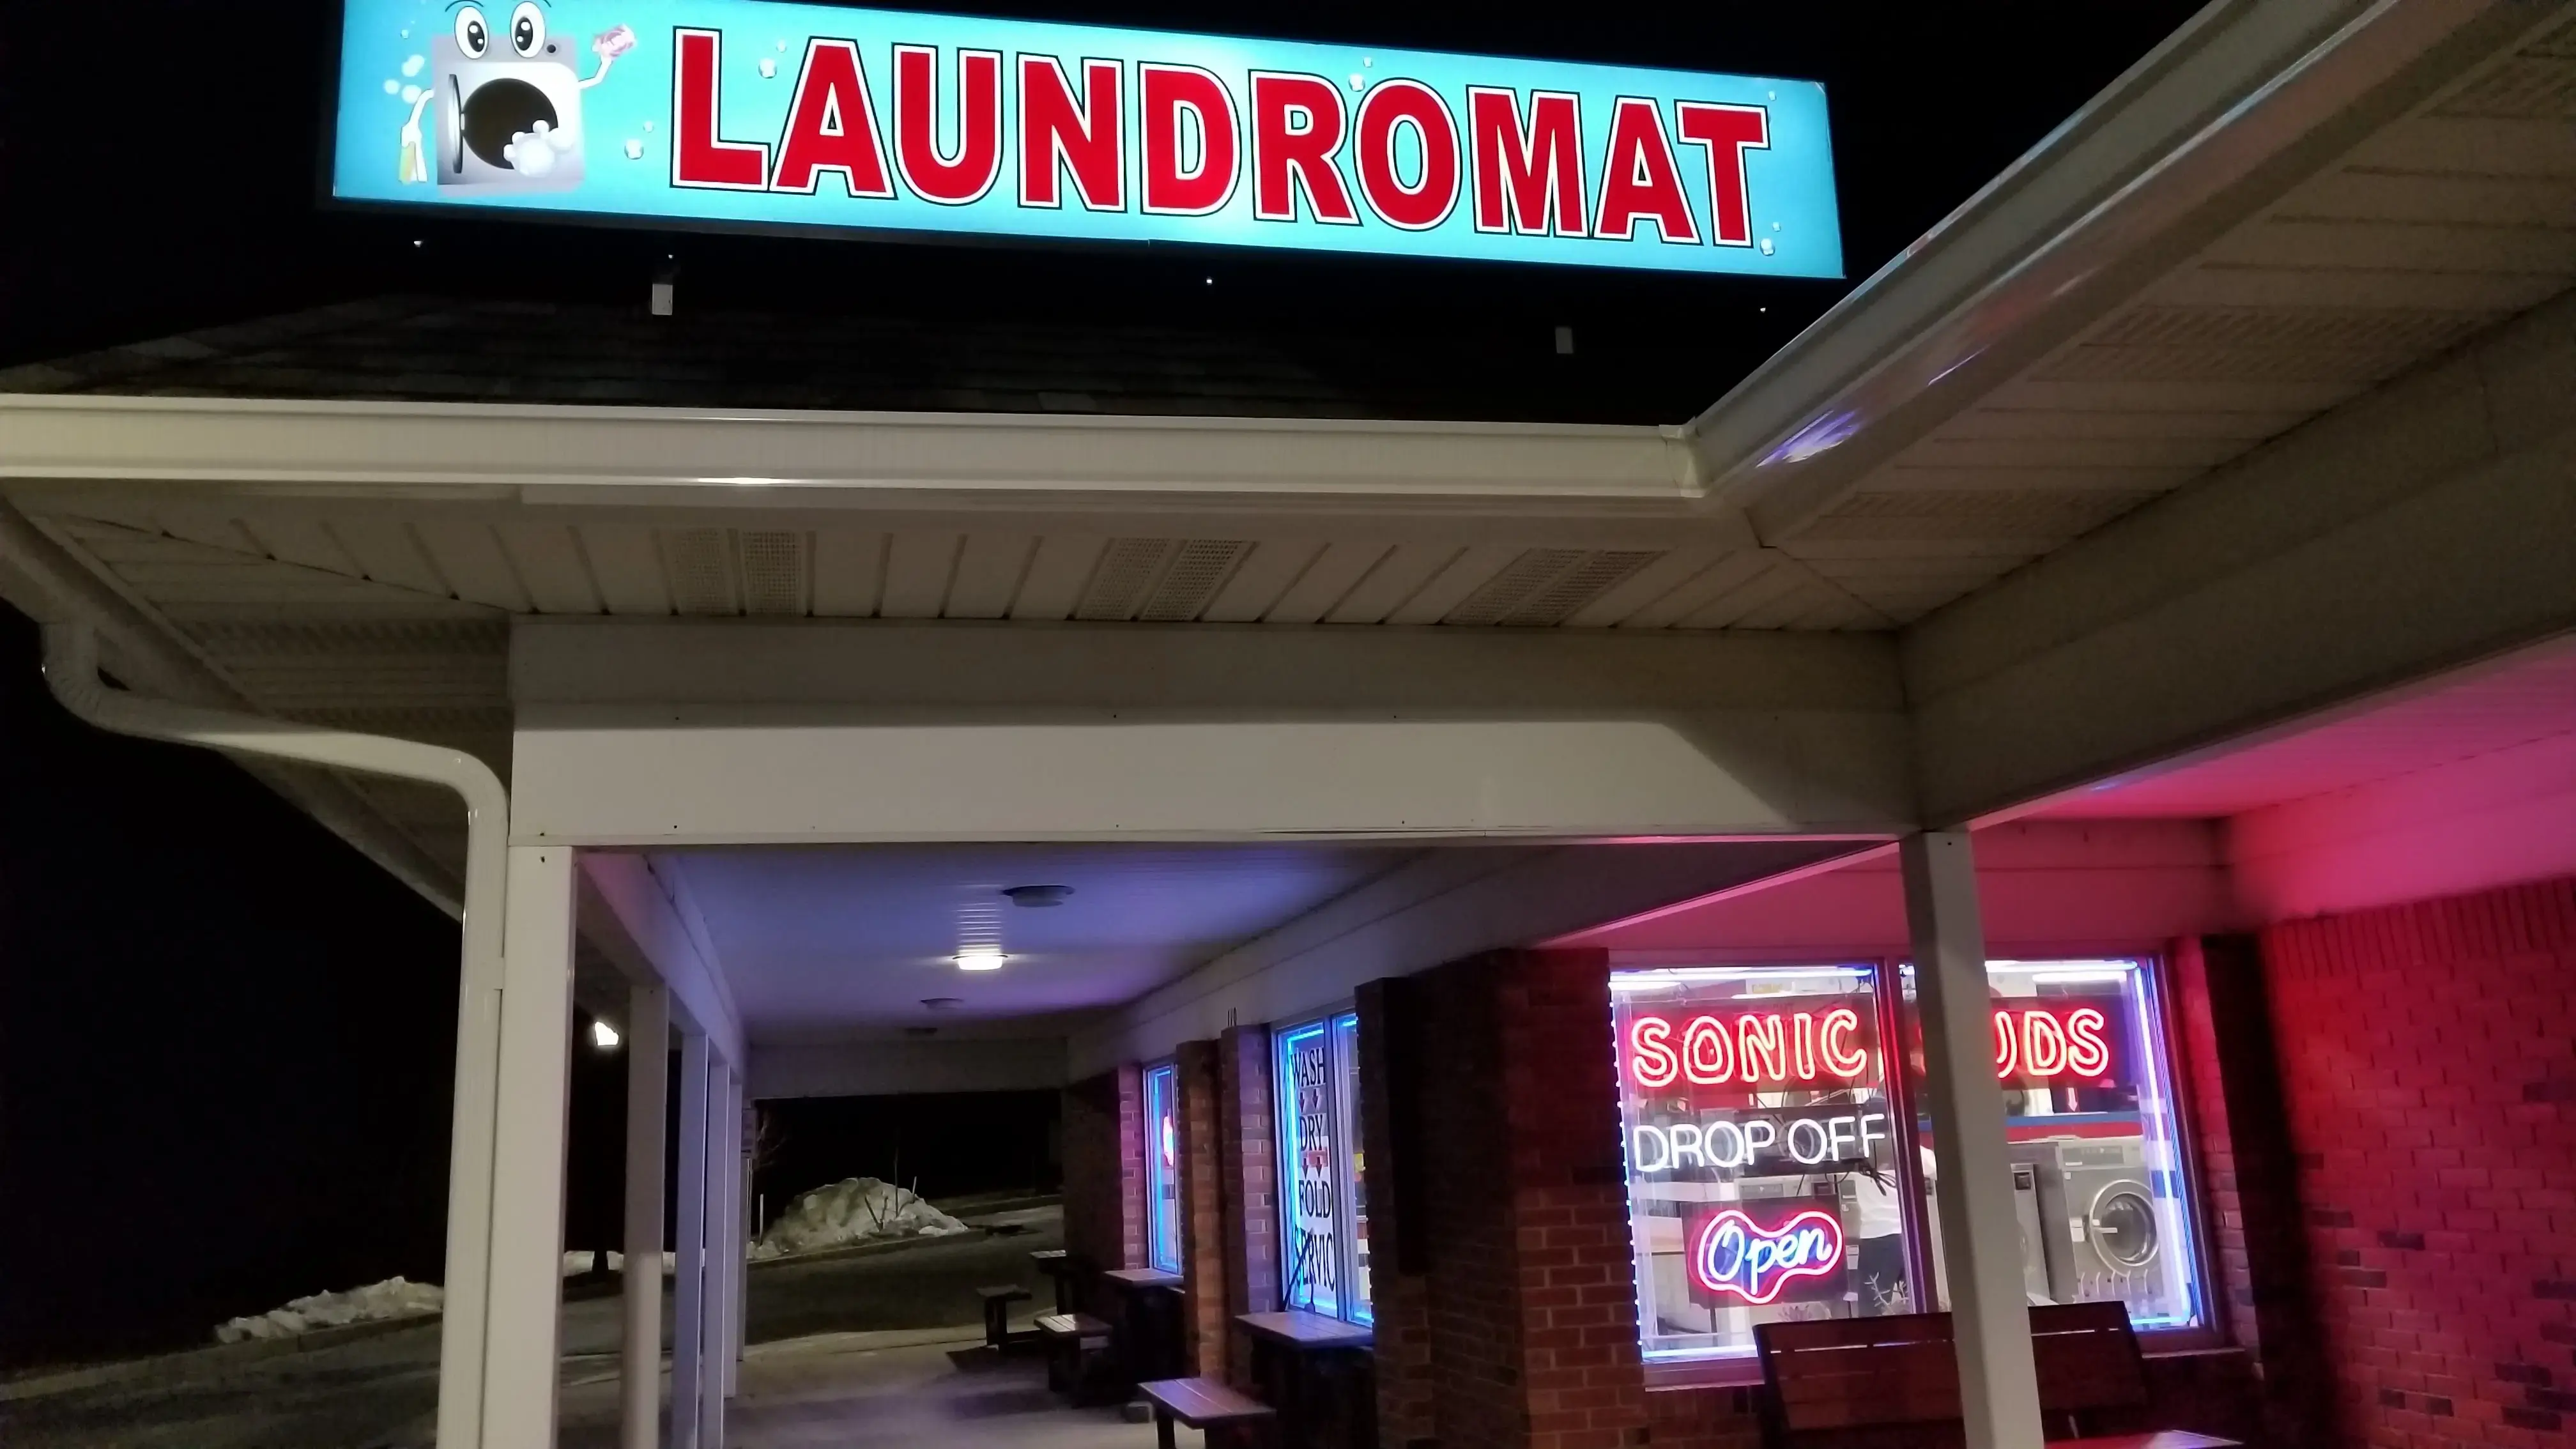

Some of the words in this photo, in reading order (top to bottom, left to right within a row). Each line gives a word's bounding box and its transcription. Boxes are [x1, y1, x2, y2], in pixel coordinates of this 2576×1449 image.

[669, 26, 1772, 249] LAUNDROMAT
[1290, 1046, 1326, 1087] WASH
[1631, 1008, 1867, 1087] SONIC
[1994, 1008, 2110, 1079] DS
[1299, 1114, 1324, 1151] DRY
[1632, 1119, 1776, 1173] DROP
[1787, 1113, 1886, 1165] OFF
[1298, 1179, 1332, 1218] FOLD
[1294, 1223, 1335, 1292] SERVIC
[1707, 1218, 1834, 1296] Open
